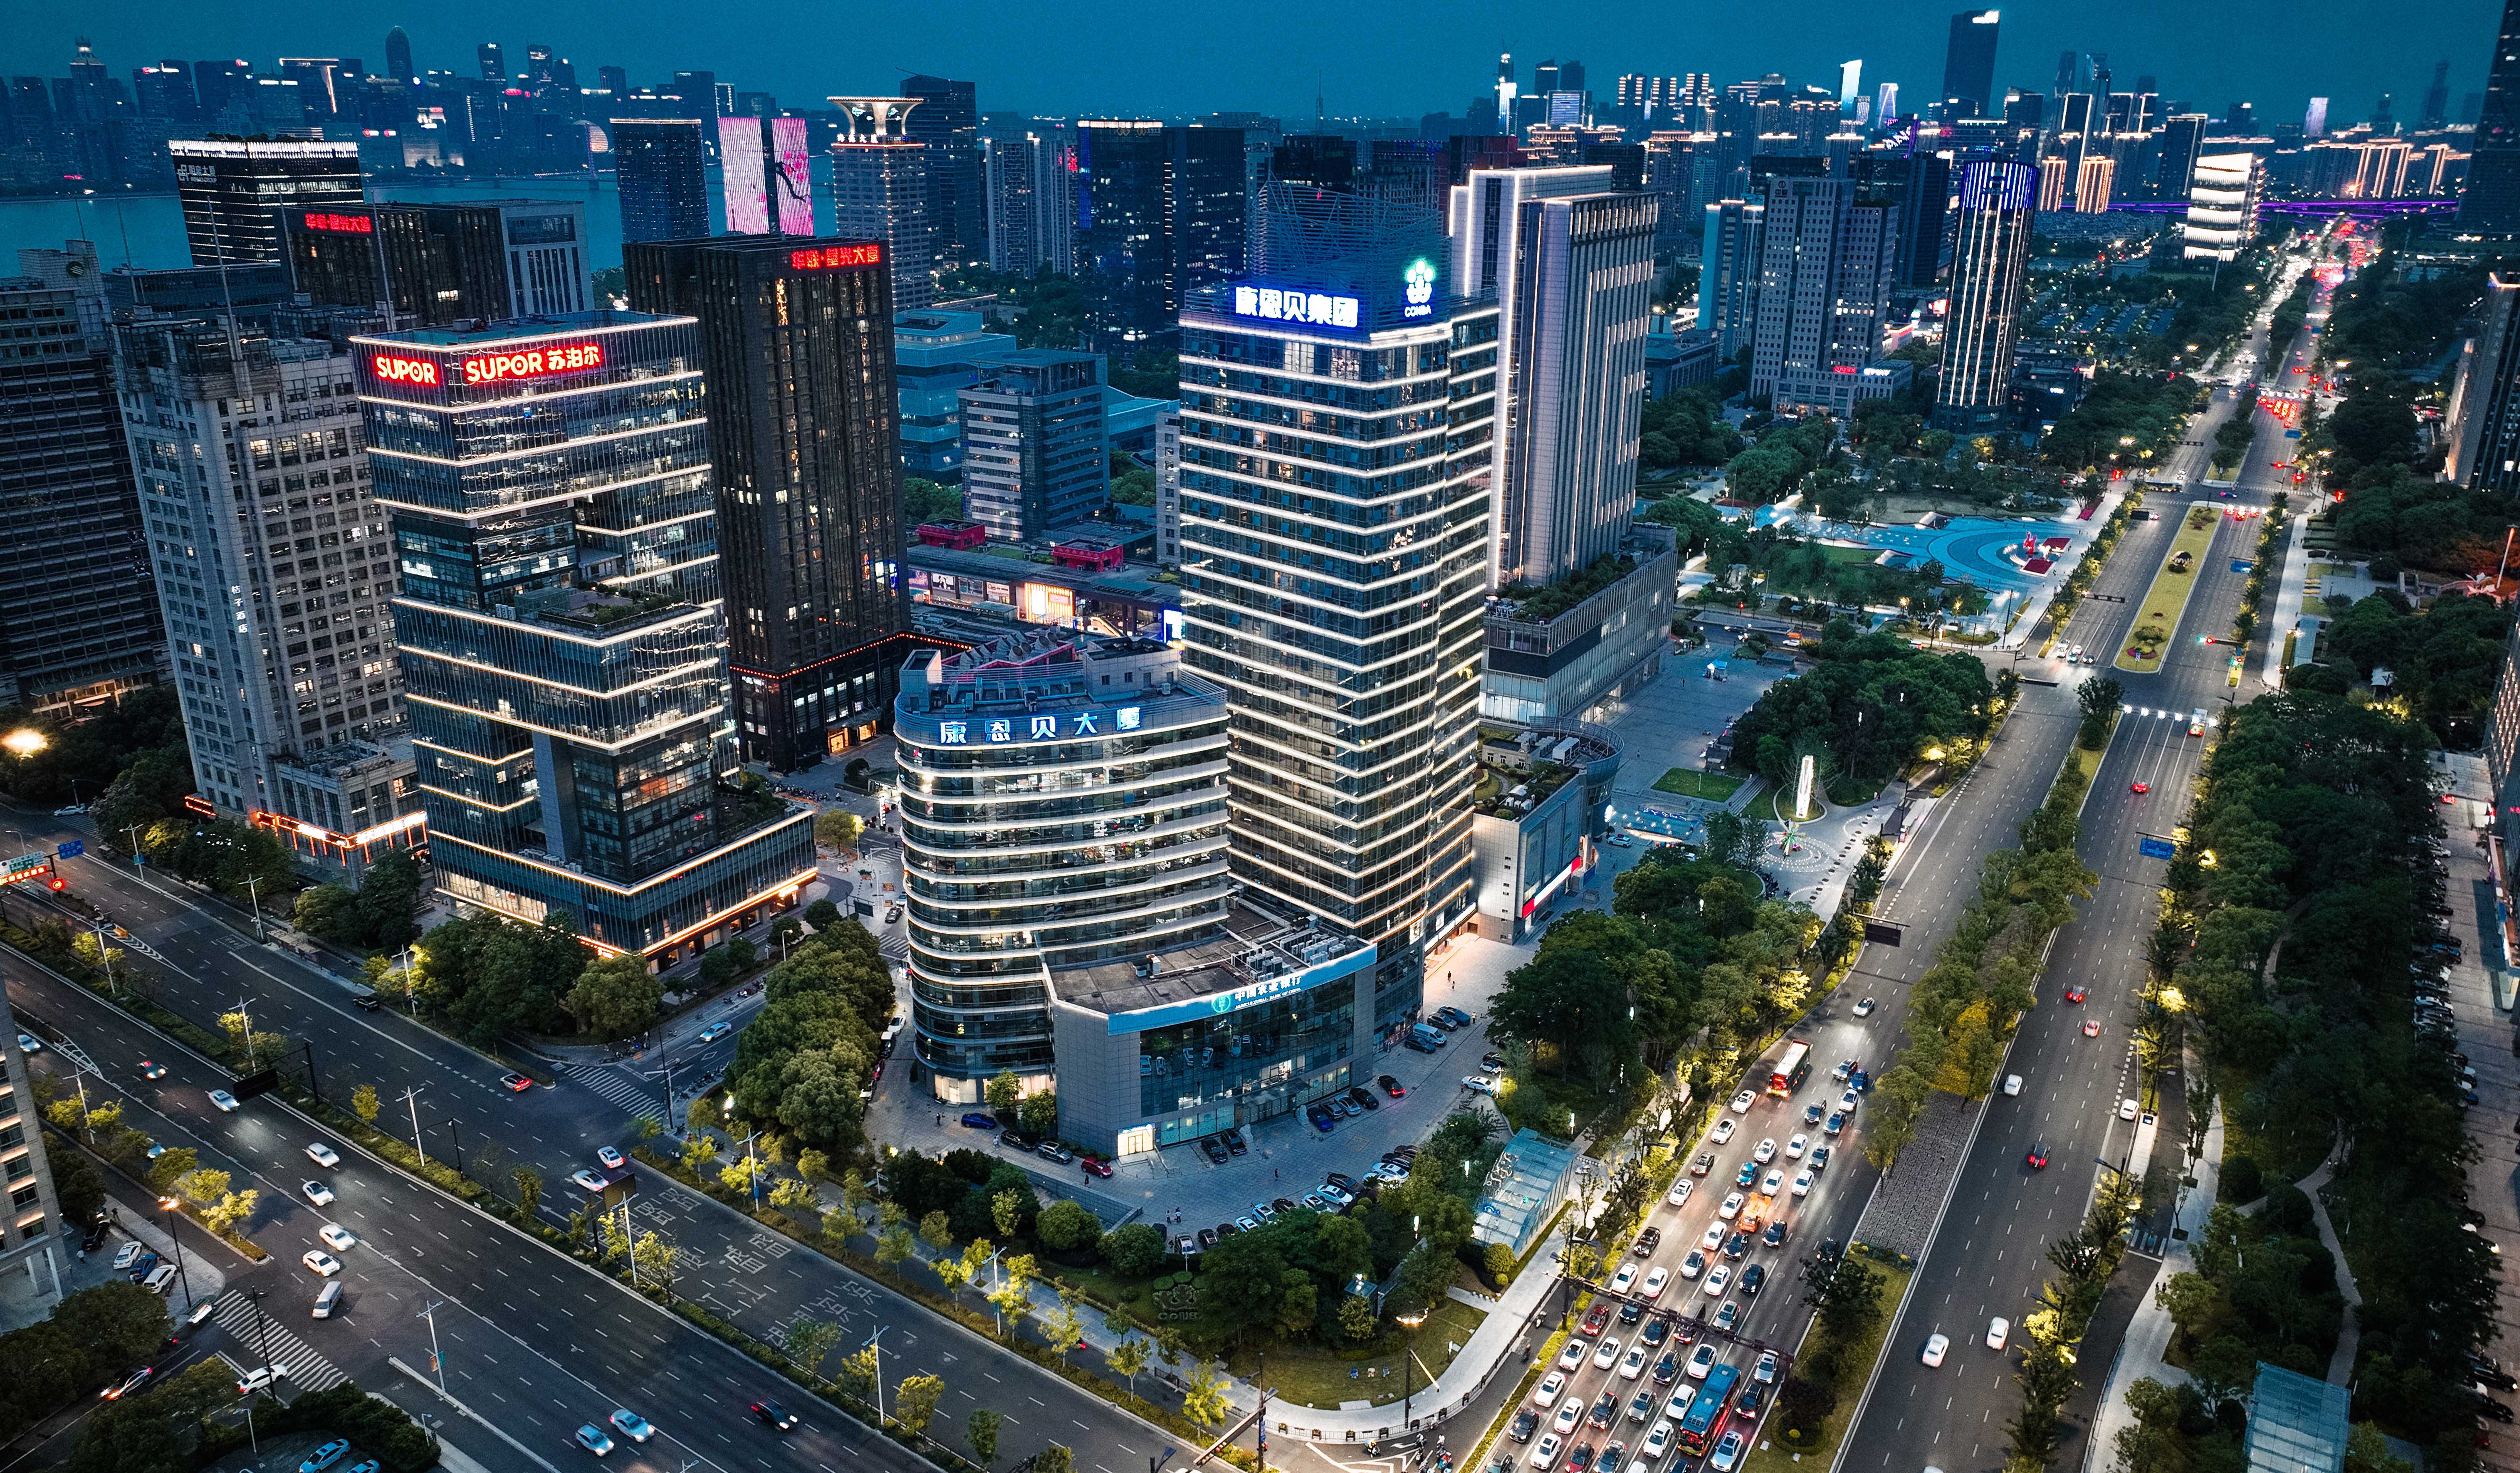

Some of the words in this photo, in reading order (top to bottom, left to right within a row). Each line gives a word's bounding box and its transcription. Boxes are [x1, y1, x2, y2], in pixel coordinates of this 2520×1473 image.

[1236, 286, 1358, 328] 康恩贝集团
[376, 356, 437, 384] SUPOR
[466, 352, 544, 382] SUPOR
[547, 346, 600, 371] 苏泊尔
[940, 707, 1141, 744] 康恩贝大厦
[1235, 975, 1302, 1001] 中国农业银行
[1235, 997, 1268, 1009] AGRICULTURAL
